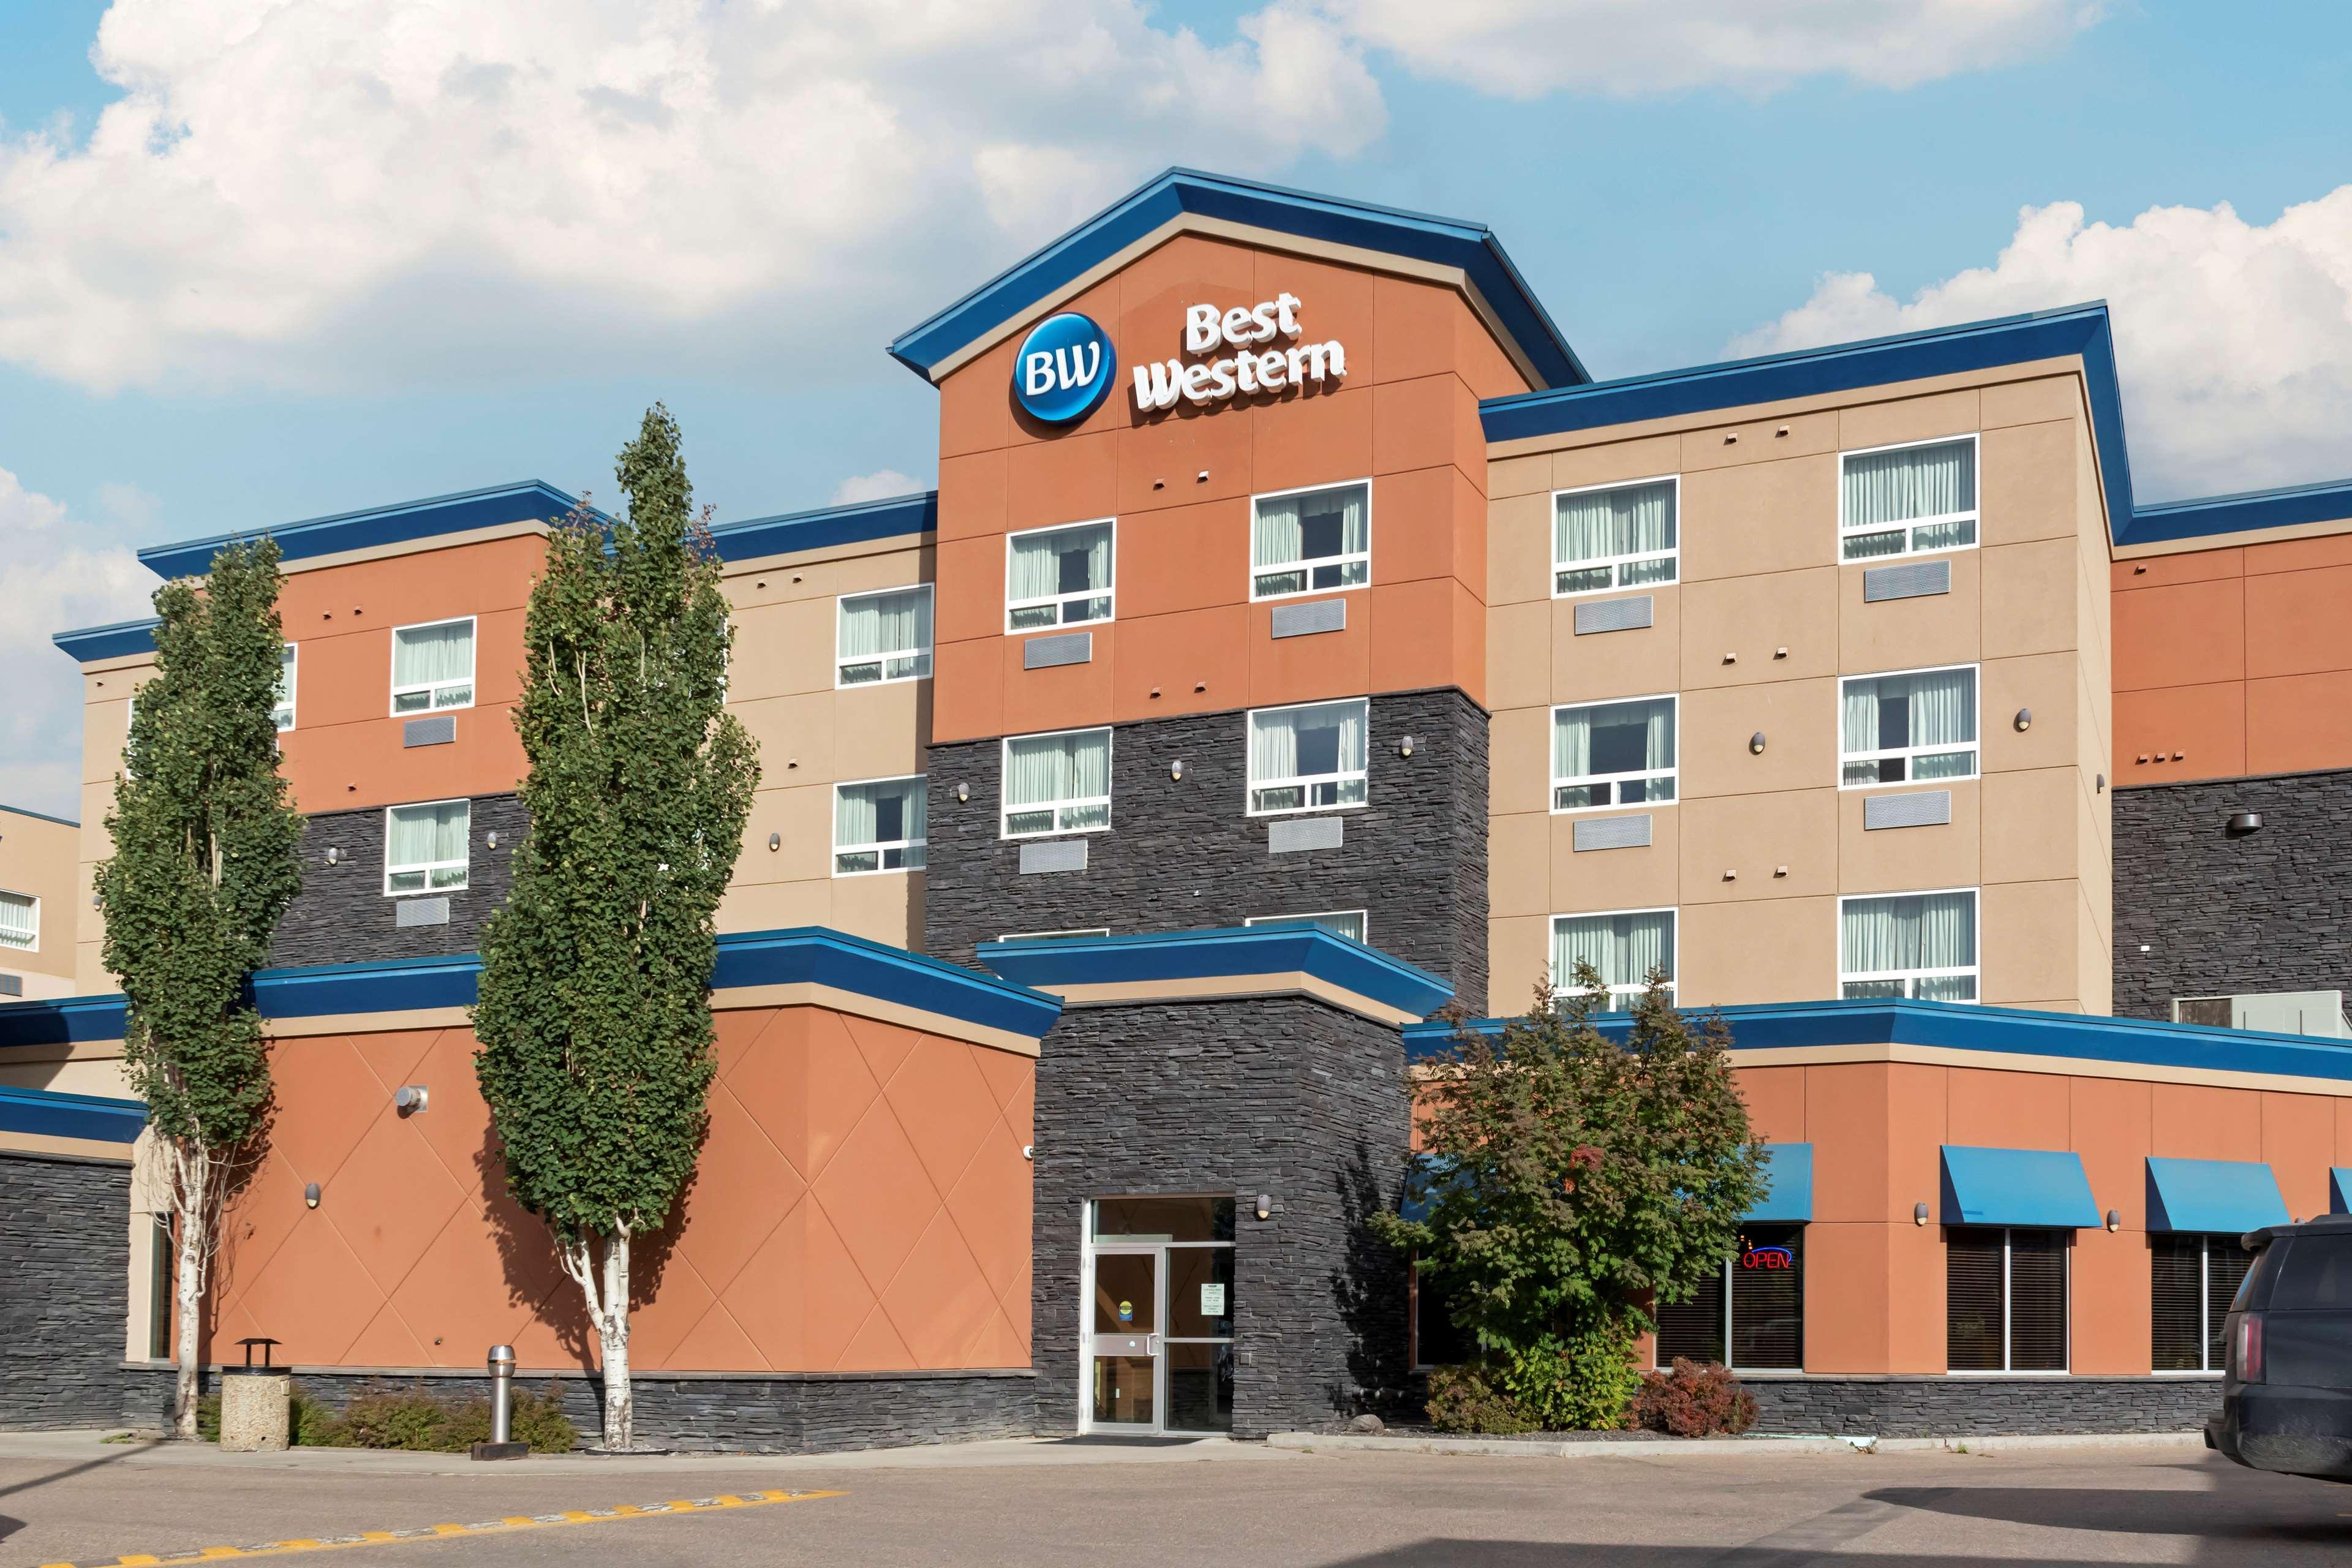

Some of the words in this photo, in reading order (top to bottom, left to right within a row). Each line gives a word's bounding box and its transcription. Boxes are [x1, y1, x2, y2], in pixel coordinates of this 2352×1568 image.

[1186, 292, 1302, 353] Best
[1025, 341, 1100, 396] BW
[1133, 340, 1347, 412] Western
[1744, 1252, 1789, 1268] OPEN
